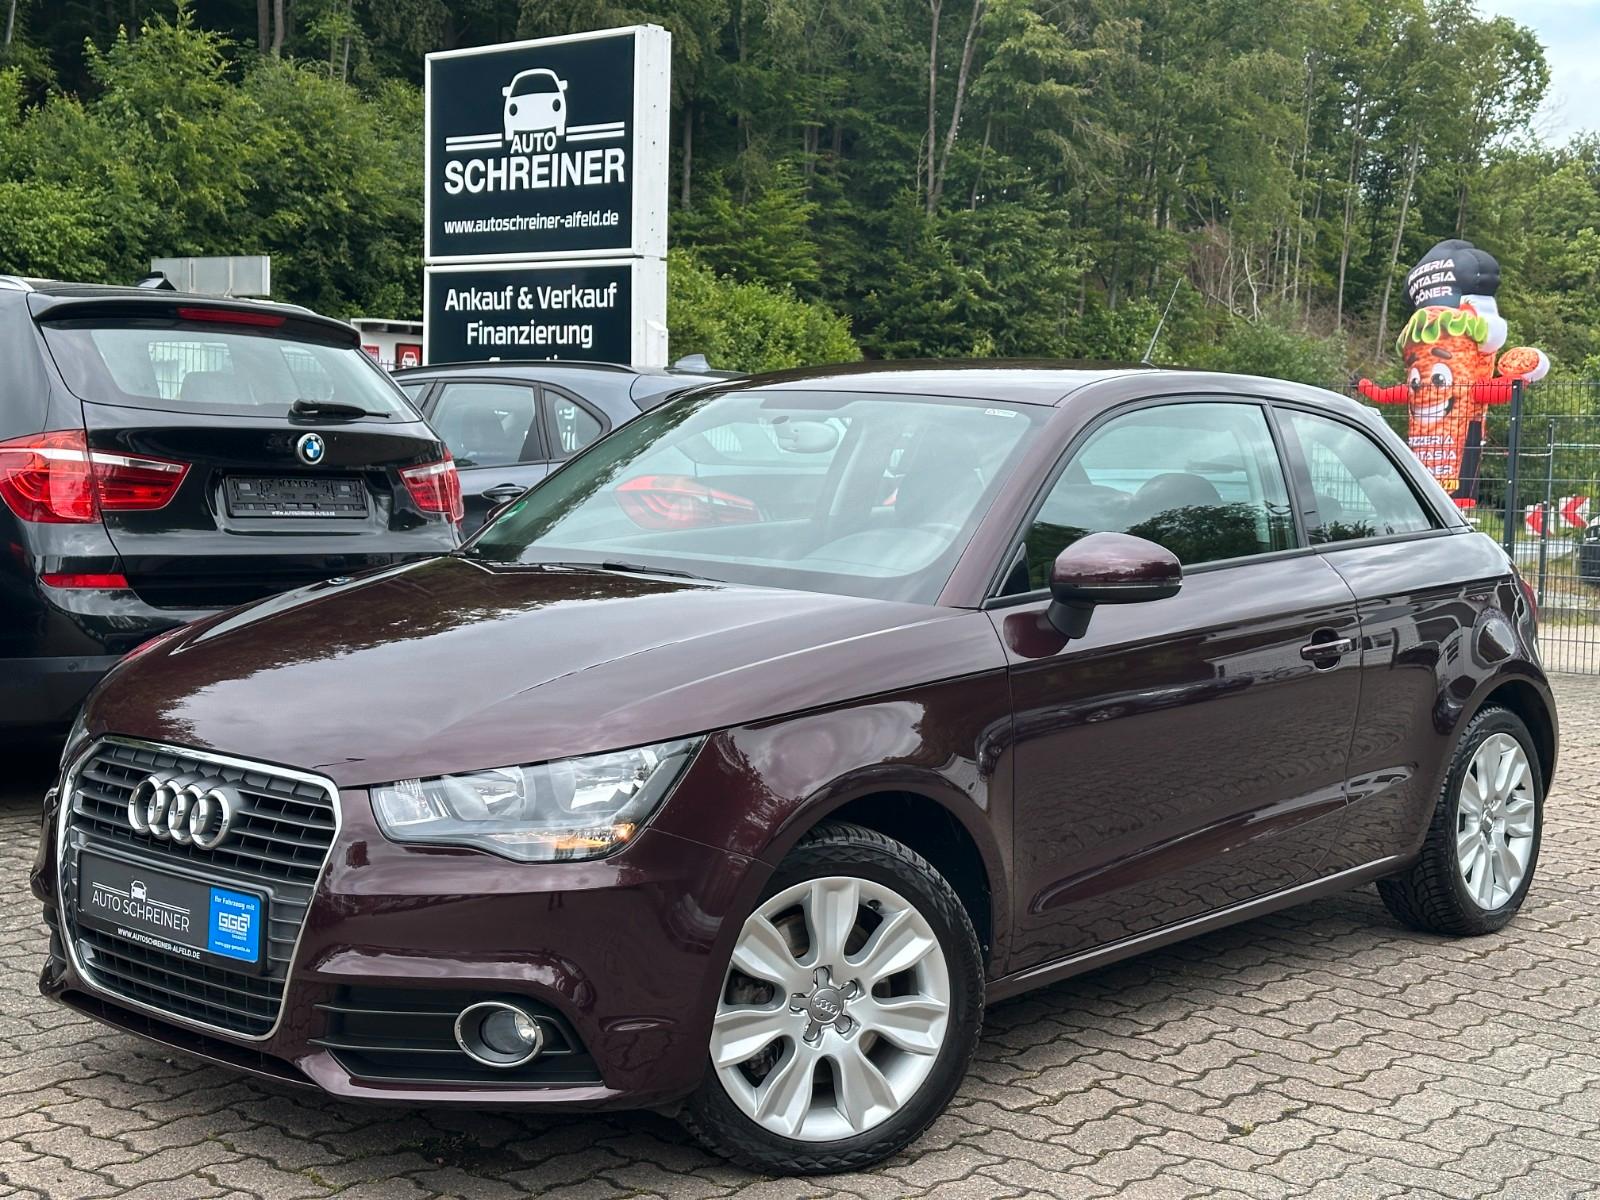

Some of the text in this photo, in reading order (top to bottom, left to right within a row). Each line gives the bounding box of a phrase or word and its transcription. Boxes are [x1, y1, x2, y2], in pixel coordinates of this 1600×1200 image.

[510, 131, 557, 154] AUTO
[444, 148, 626, 195] SCHREINER
[444, 209, 619, 234] www.autoschreiner-alfeld.de
[444, 282, 618, 311] Ankauf & Verkauf
[1409, 271, 1457, 299] ANTASIA
[466, 319, 593, 348] Finanzierung
[92, 889, 190, 933] AUTO SCHREINER
[218, 911, 250, 932] GGG
[117, 927, 201, 960] WWW.AUTOSCHREINER-ALFELD.DE
